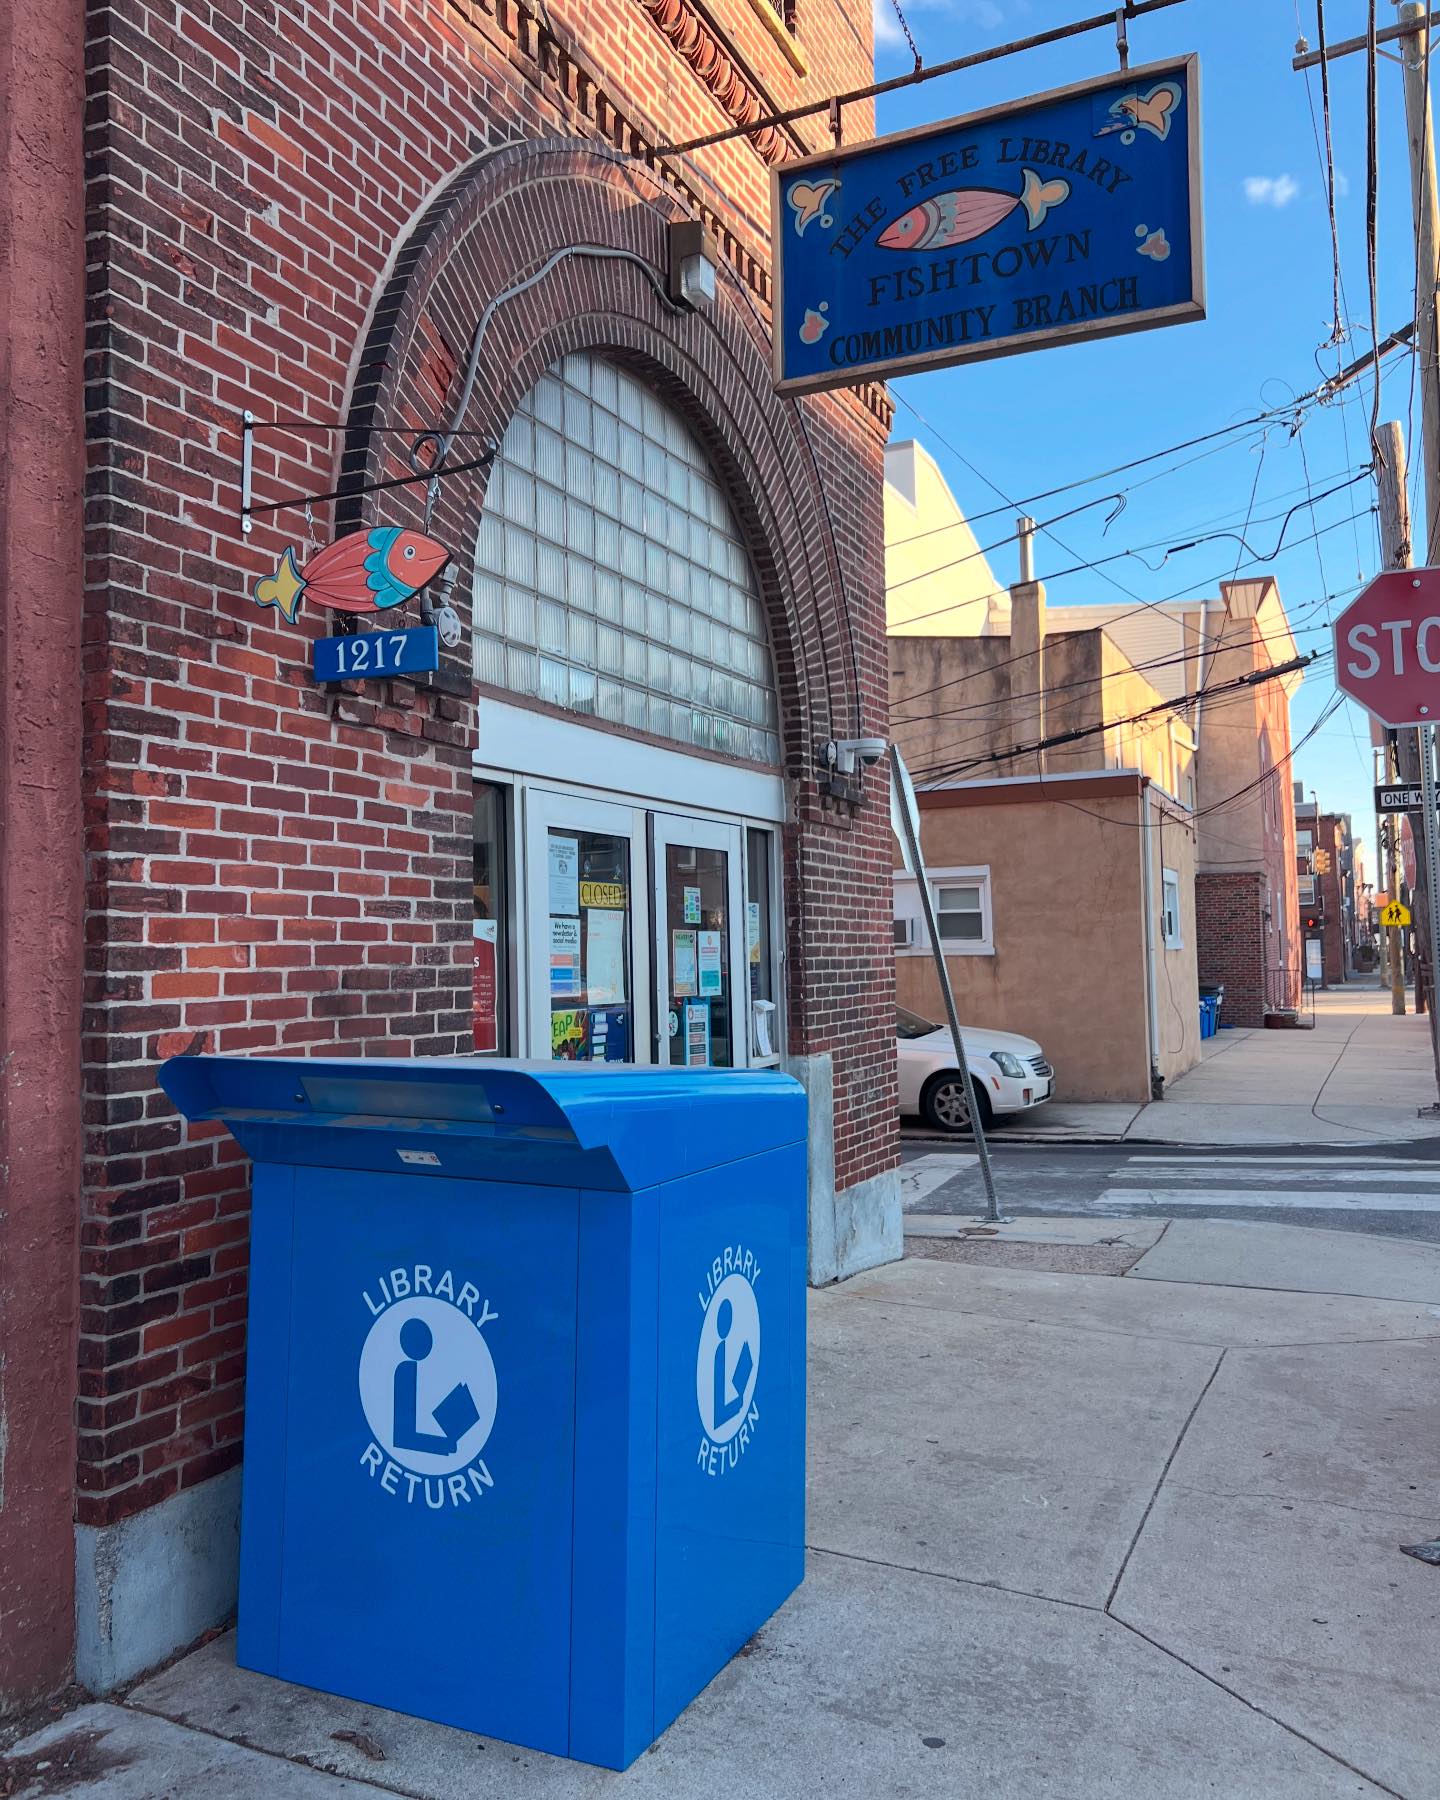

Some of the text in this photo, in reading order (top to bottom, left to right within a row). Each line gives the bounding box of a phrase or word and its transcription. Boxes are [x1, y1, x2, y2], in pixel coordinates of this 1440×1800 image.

[828, 136, 1133, 260] THE FREE LIBRARY
[867, 230, 1092, 307] FISHTOWN
[829, 275, 1141, 366] COMMUNITY BRANCH
[336, 635, 408, 673] 1217
[1347, 616, 1440, 679] STO
[1384, 791, 1440, 804] ONE WY
[581, 884, 621, 905] CLOSED
[551, 1014, 573, 1037] EAP
[362, 1264, 499, 1328] LIBRARY
[698, 1244, 761, 1312] LIBRARY
[697, 1400, 760, 1477] RETURN
[359, 1441, 494, 1509] RETURN
